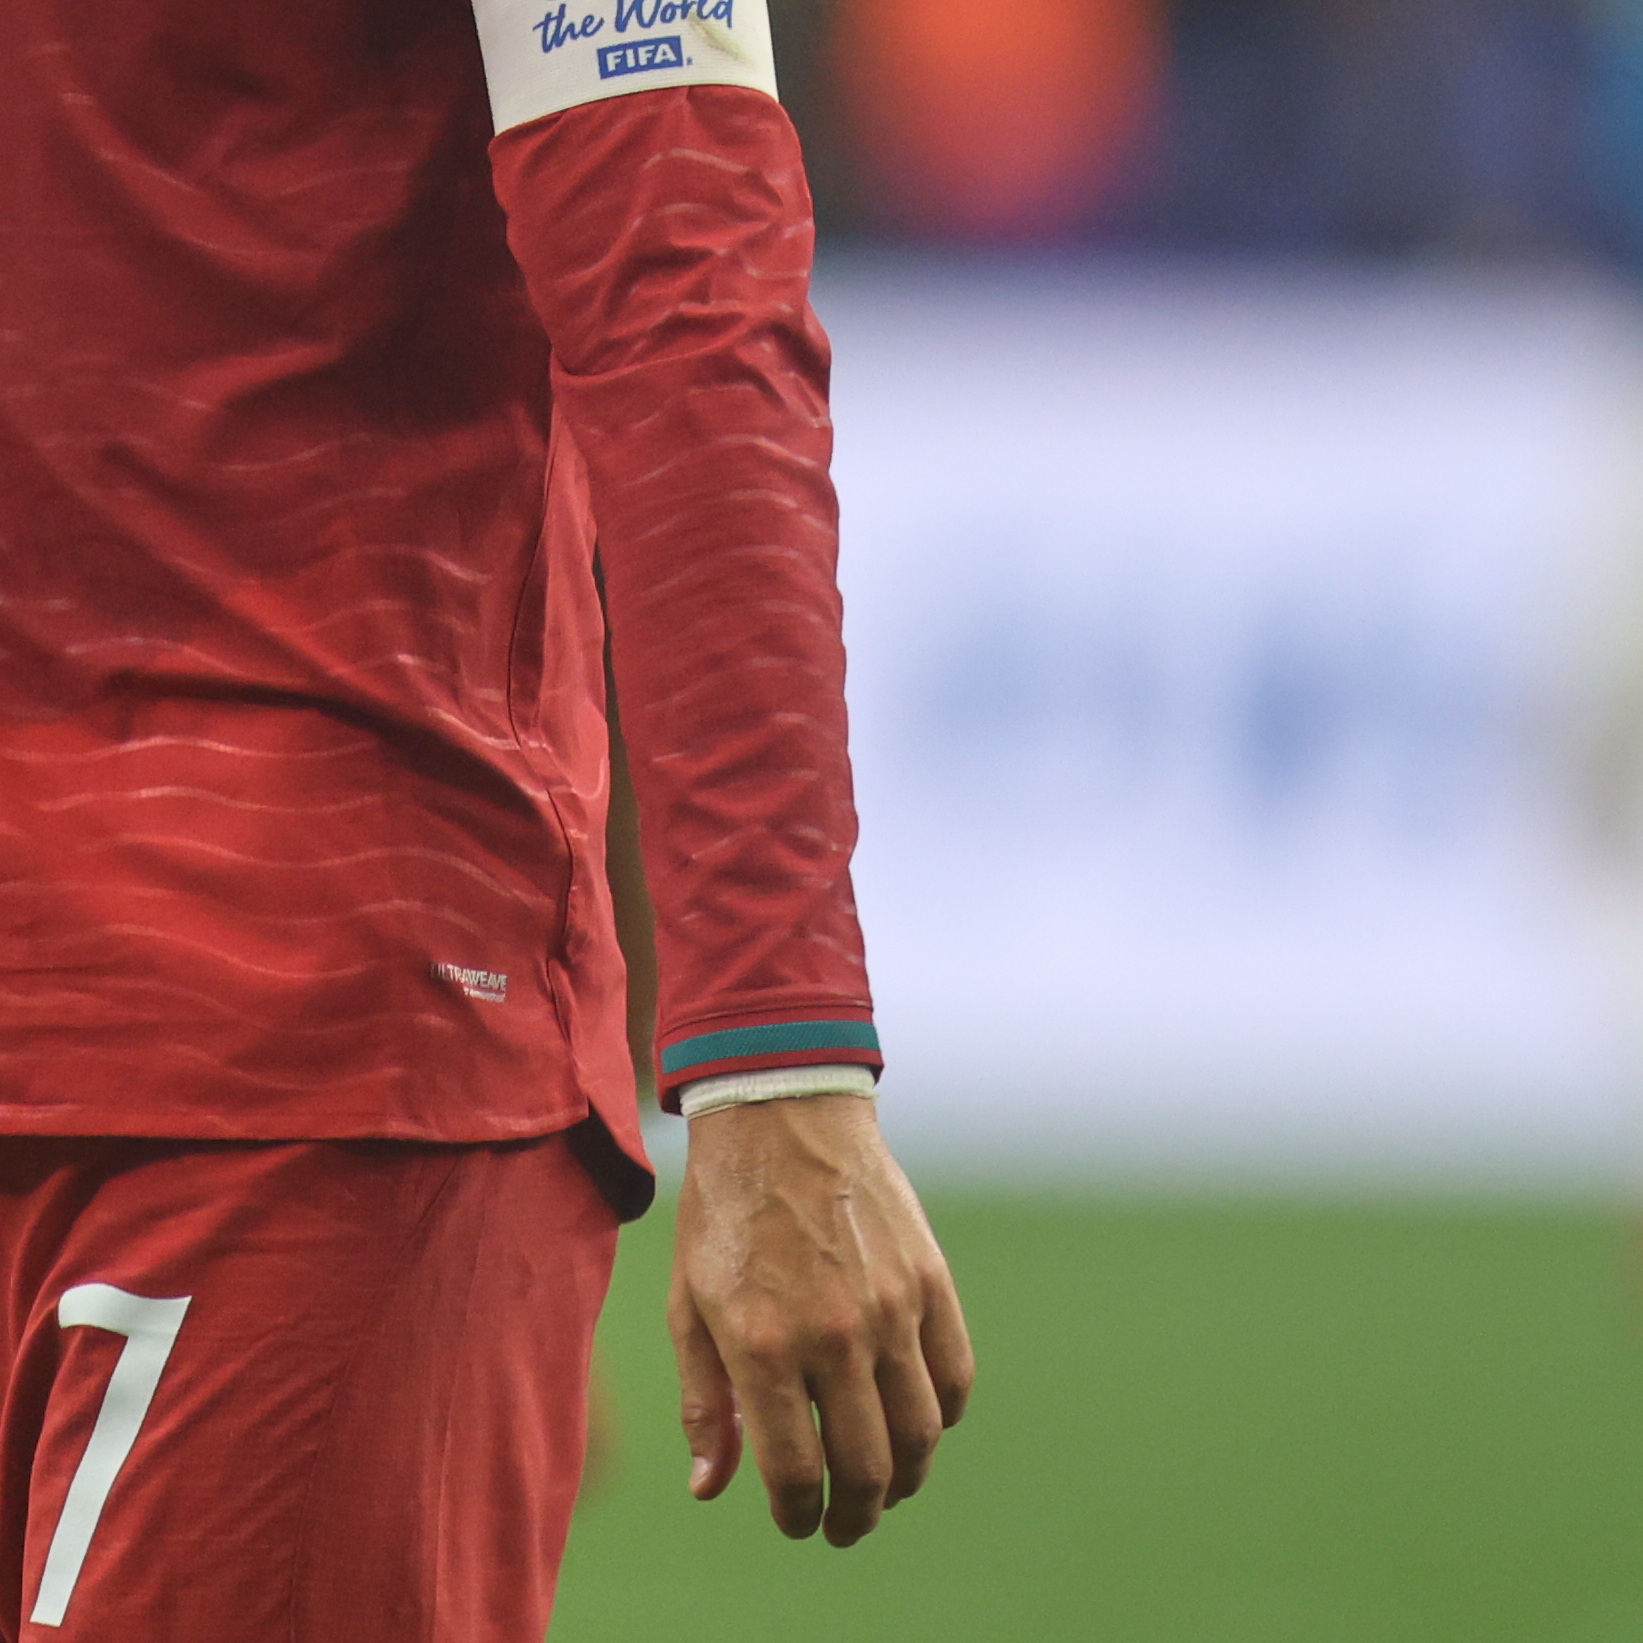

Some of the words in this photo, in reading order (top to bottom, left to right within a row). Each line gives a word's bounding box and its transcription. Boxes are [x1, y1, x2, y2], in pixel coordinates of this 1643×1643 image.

[532, 4, 605, 54] the
[605, 43, 677, 74] FIFA
[29, 1282, 193, 1627] 7
